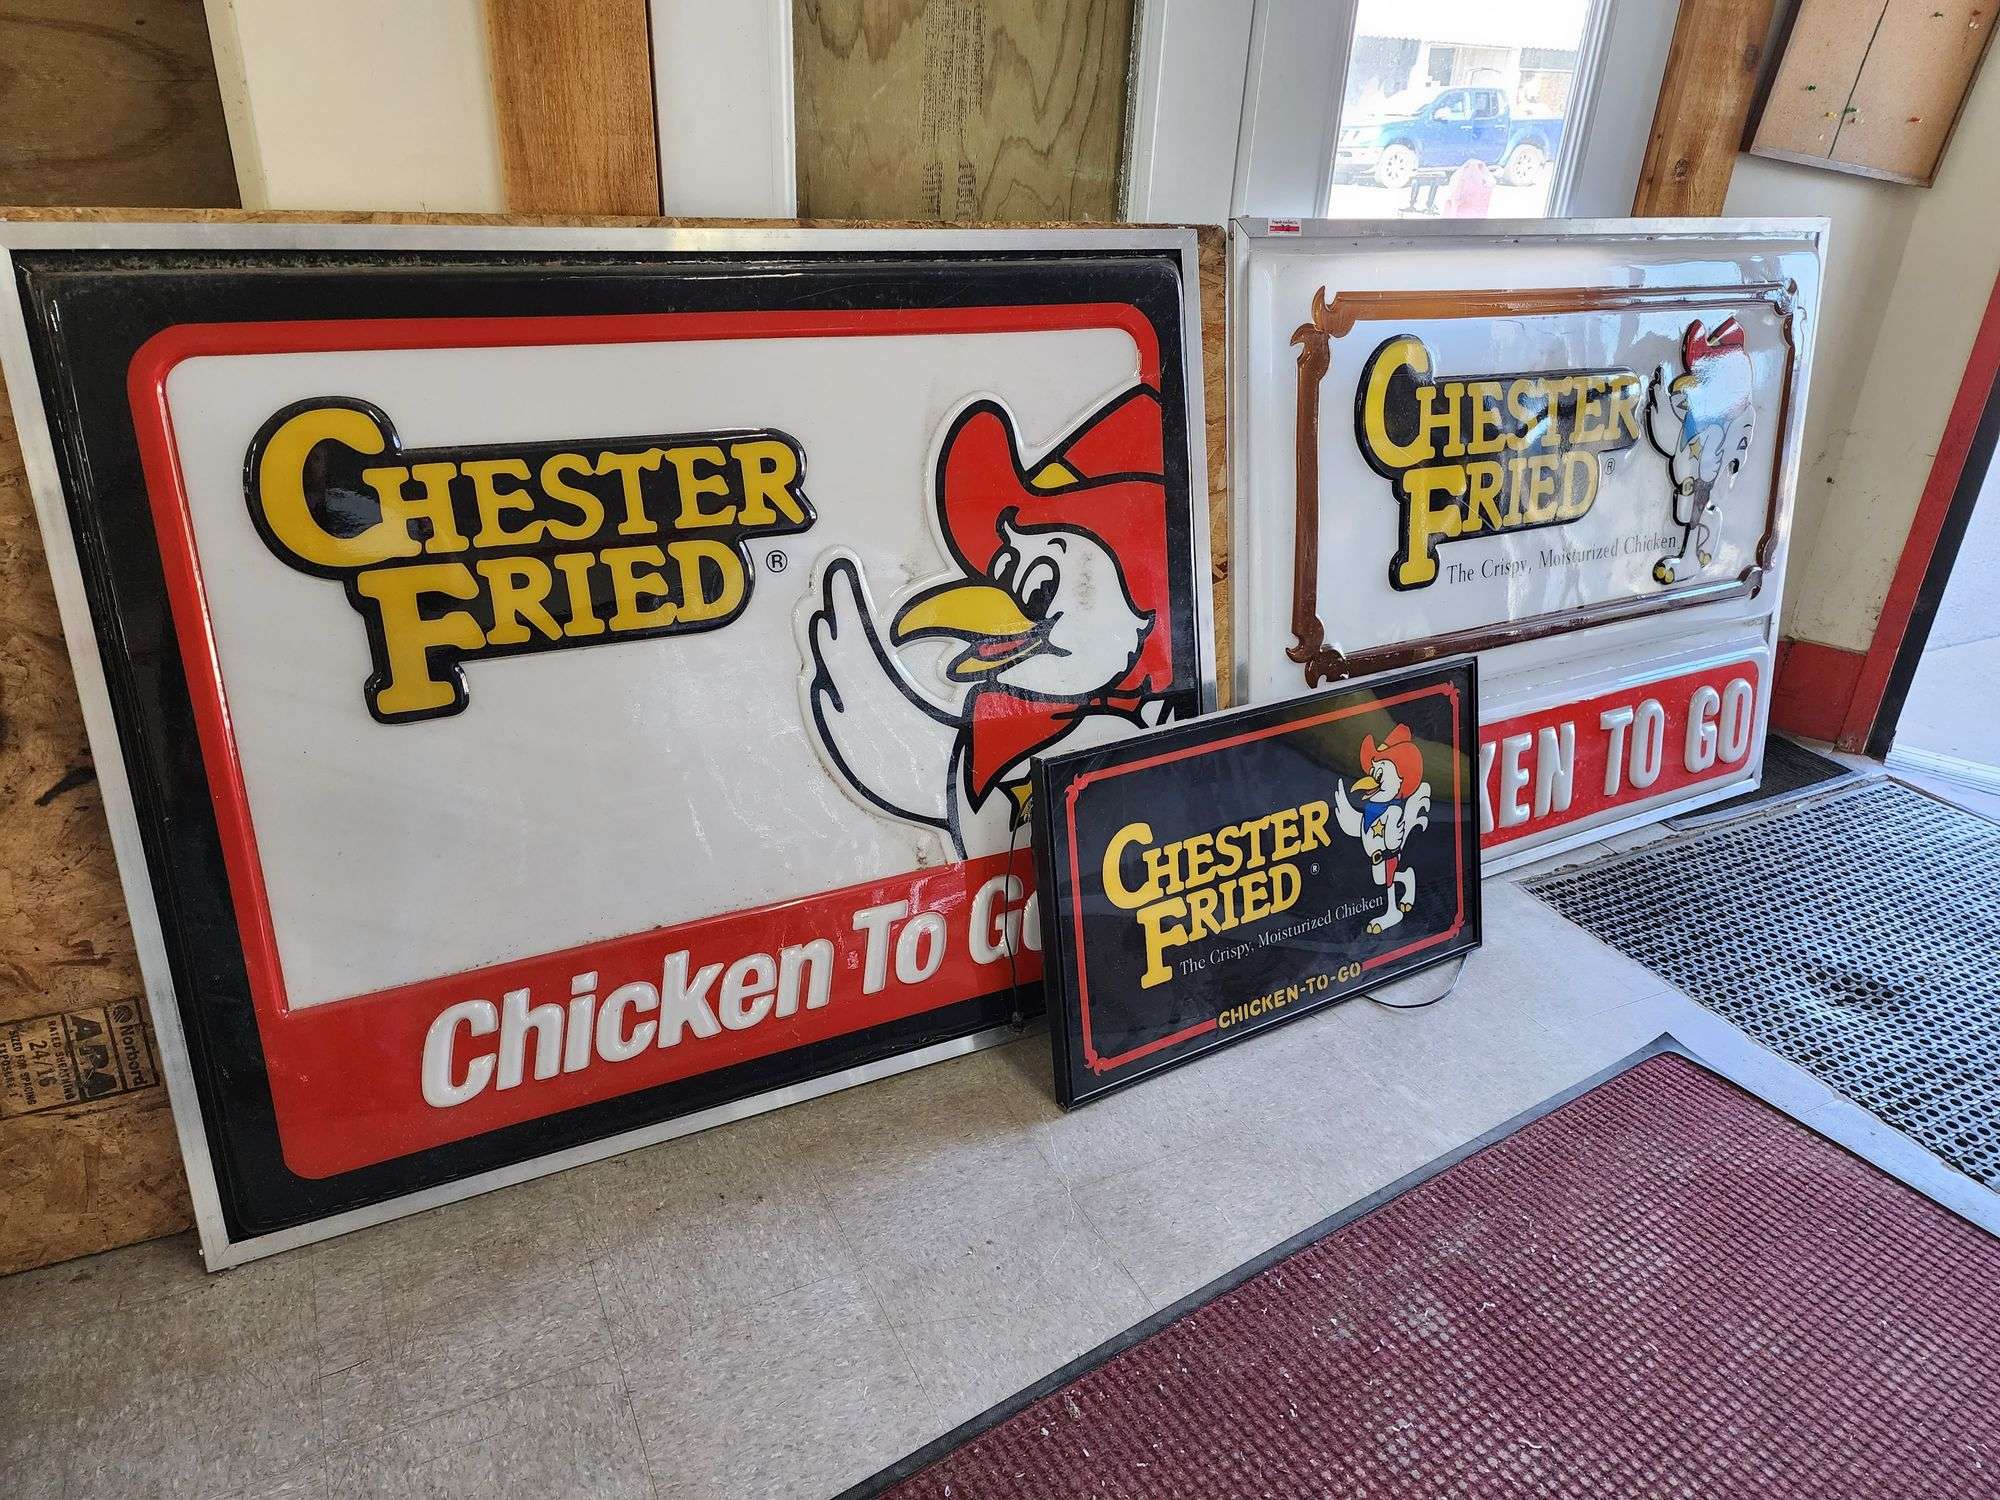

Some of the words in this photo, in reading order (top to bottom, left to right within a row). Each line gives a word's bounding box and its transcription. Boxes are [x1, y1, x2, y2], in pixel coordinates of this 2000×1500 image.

[1364, 340, 1641, 467] CHESTER
[260, 408, 805, 567] CHESTER
[1402, 452, 1598, 585] FRIED
[1447, 564, 1475, 584] The
[1481, 558, 1533, 578] Crispy,
[1539, 537, 1618, 568] Moisturized
[357, 540, 745, 715] FRIED
[1600, 698, 1665, 796] TO
[1684, 678, 1753, 773] GO
[1102, 800, 1332, 909] CHESTER
[1136, 863, 1303, 989] FRIED
[1179, 957, 1206, 976] The
[1210, 940, 1255, 964] Crispy,
[1257, 908, 1333, 949] Moisturized
[1335, 894, 1384, 921] Chicken
[47, 1019, 62, 1048] RATED
[422, 938, 835, 1108] Chicken
[853, 899, 947, 995] To
[1218, 961, 1362, 1029] CHICKEN-TO-GO
[19, 1071, 37, 1105] SPACING
[120, 1025, 148, 1087] Norbord
